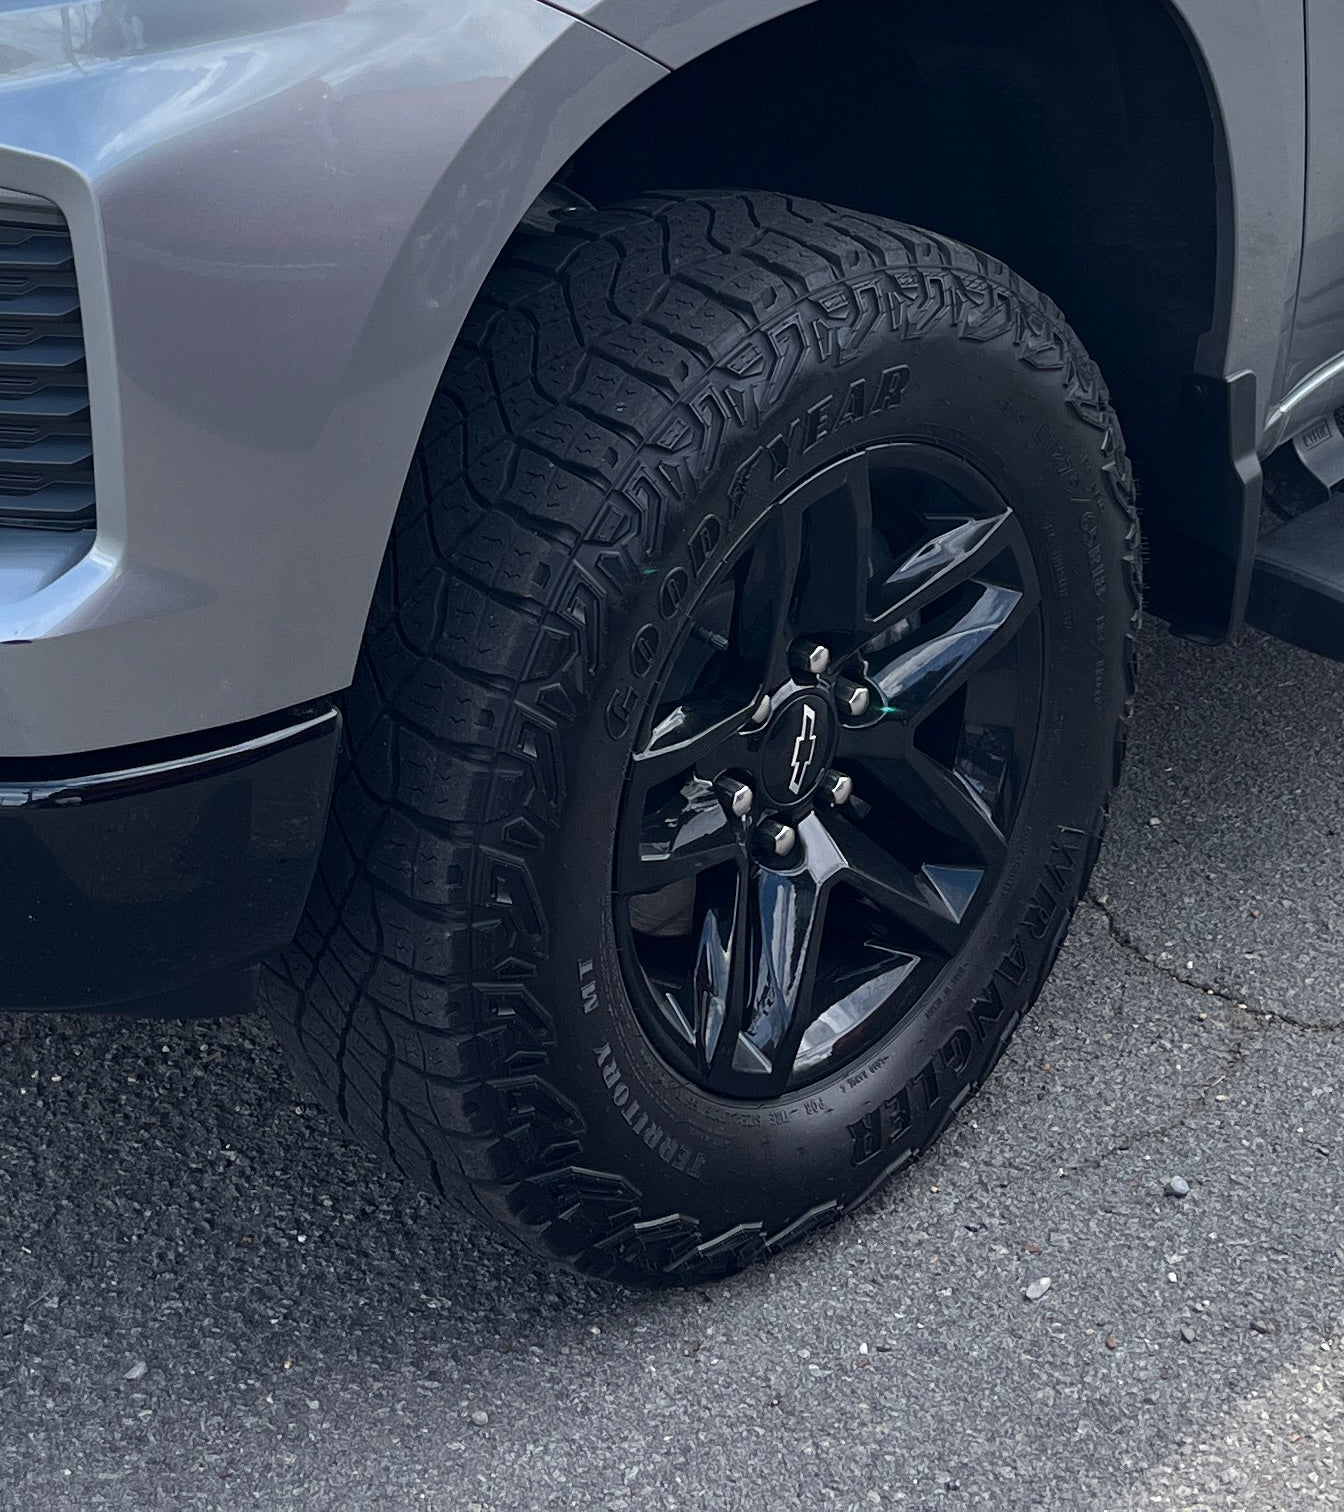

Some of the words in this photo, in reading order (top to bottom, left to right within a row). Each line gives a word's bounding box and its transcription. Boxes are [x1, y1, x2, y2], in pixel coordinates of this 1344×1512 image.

[577, 956, 600, 1015] MT
[849, 824, 1088, 1168] WRANGLER
[590, 1040, 705, 1180] TERRITORY
